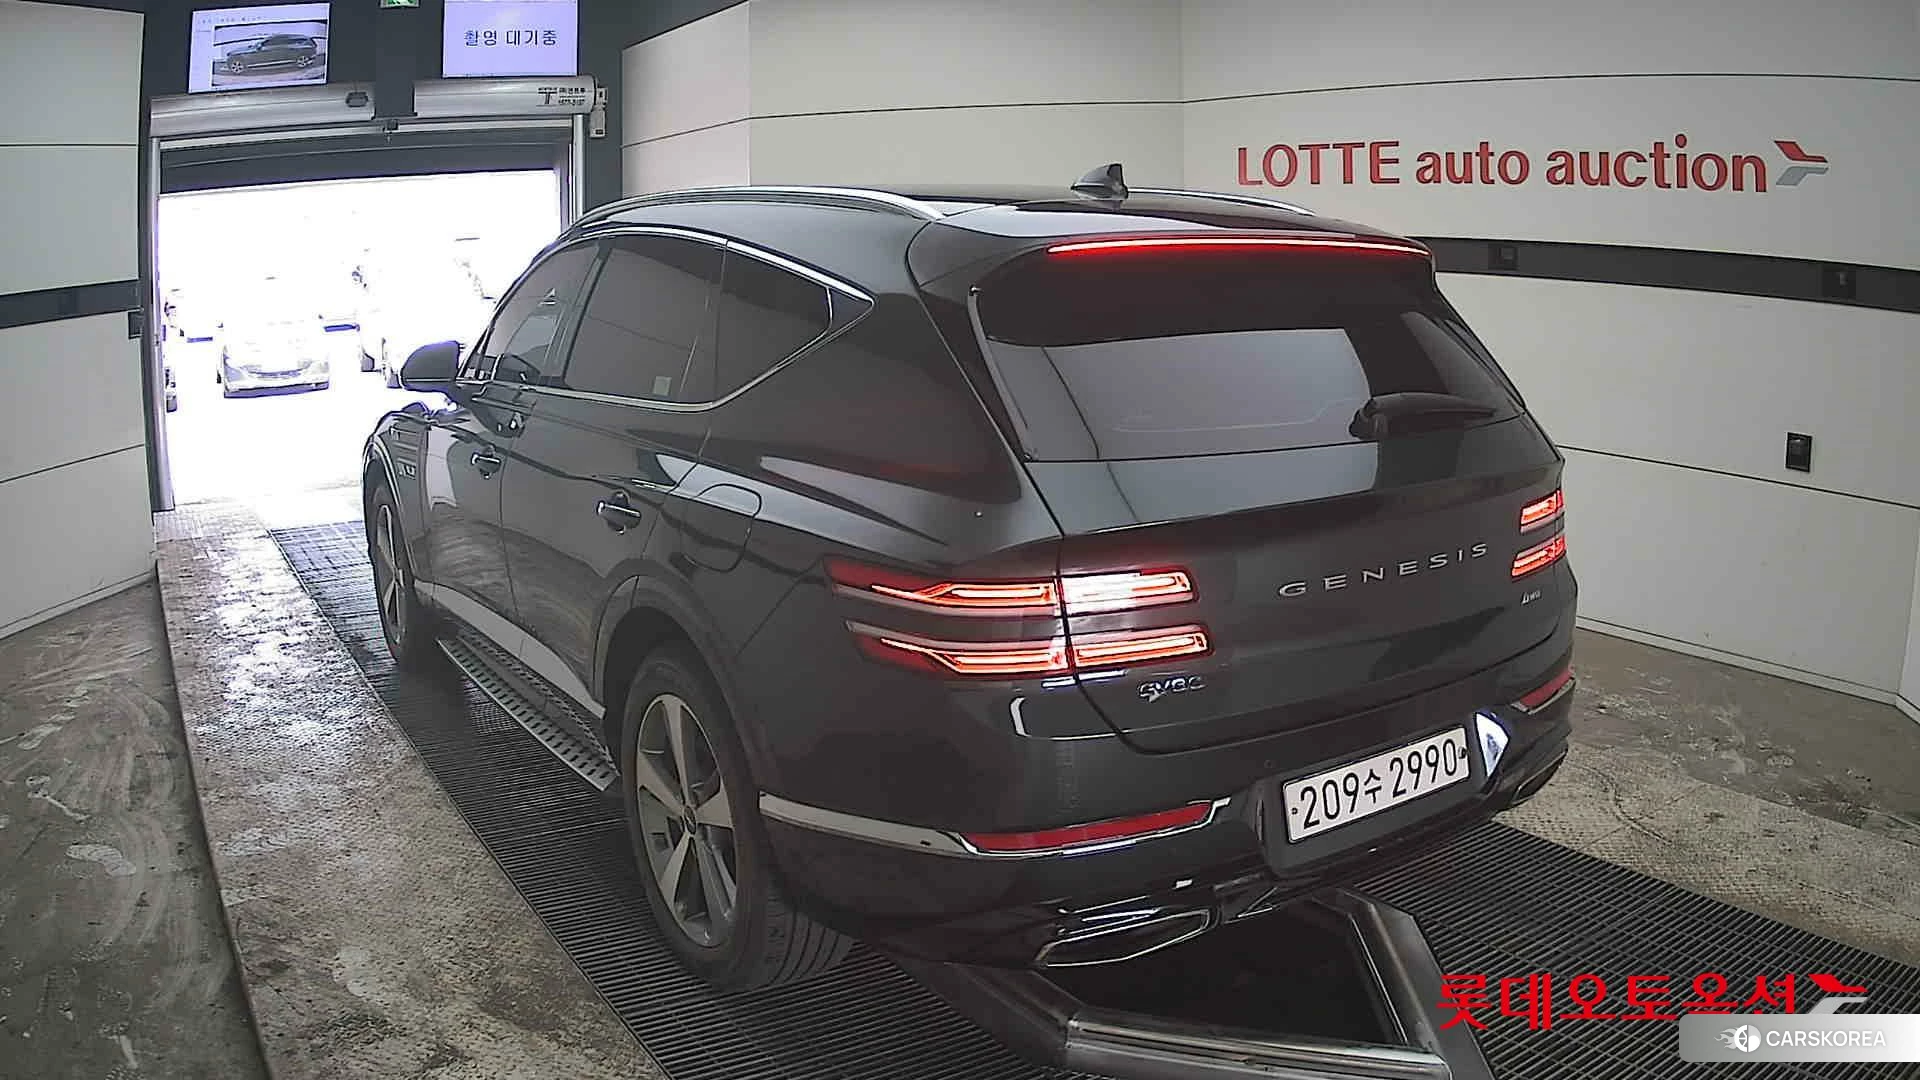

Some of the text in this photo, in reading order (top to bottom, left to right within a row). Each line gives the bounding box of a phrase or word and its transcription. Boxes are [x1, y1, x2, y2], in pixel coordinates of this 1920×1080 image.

[506, 30, 557, 46] 대기중
[1237, 133, 1768, 193] LOTTE auto auction
[1279, 543, 1488, 597] GENESIS
